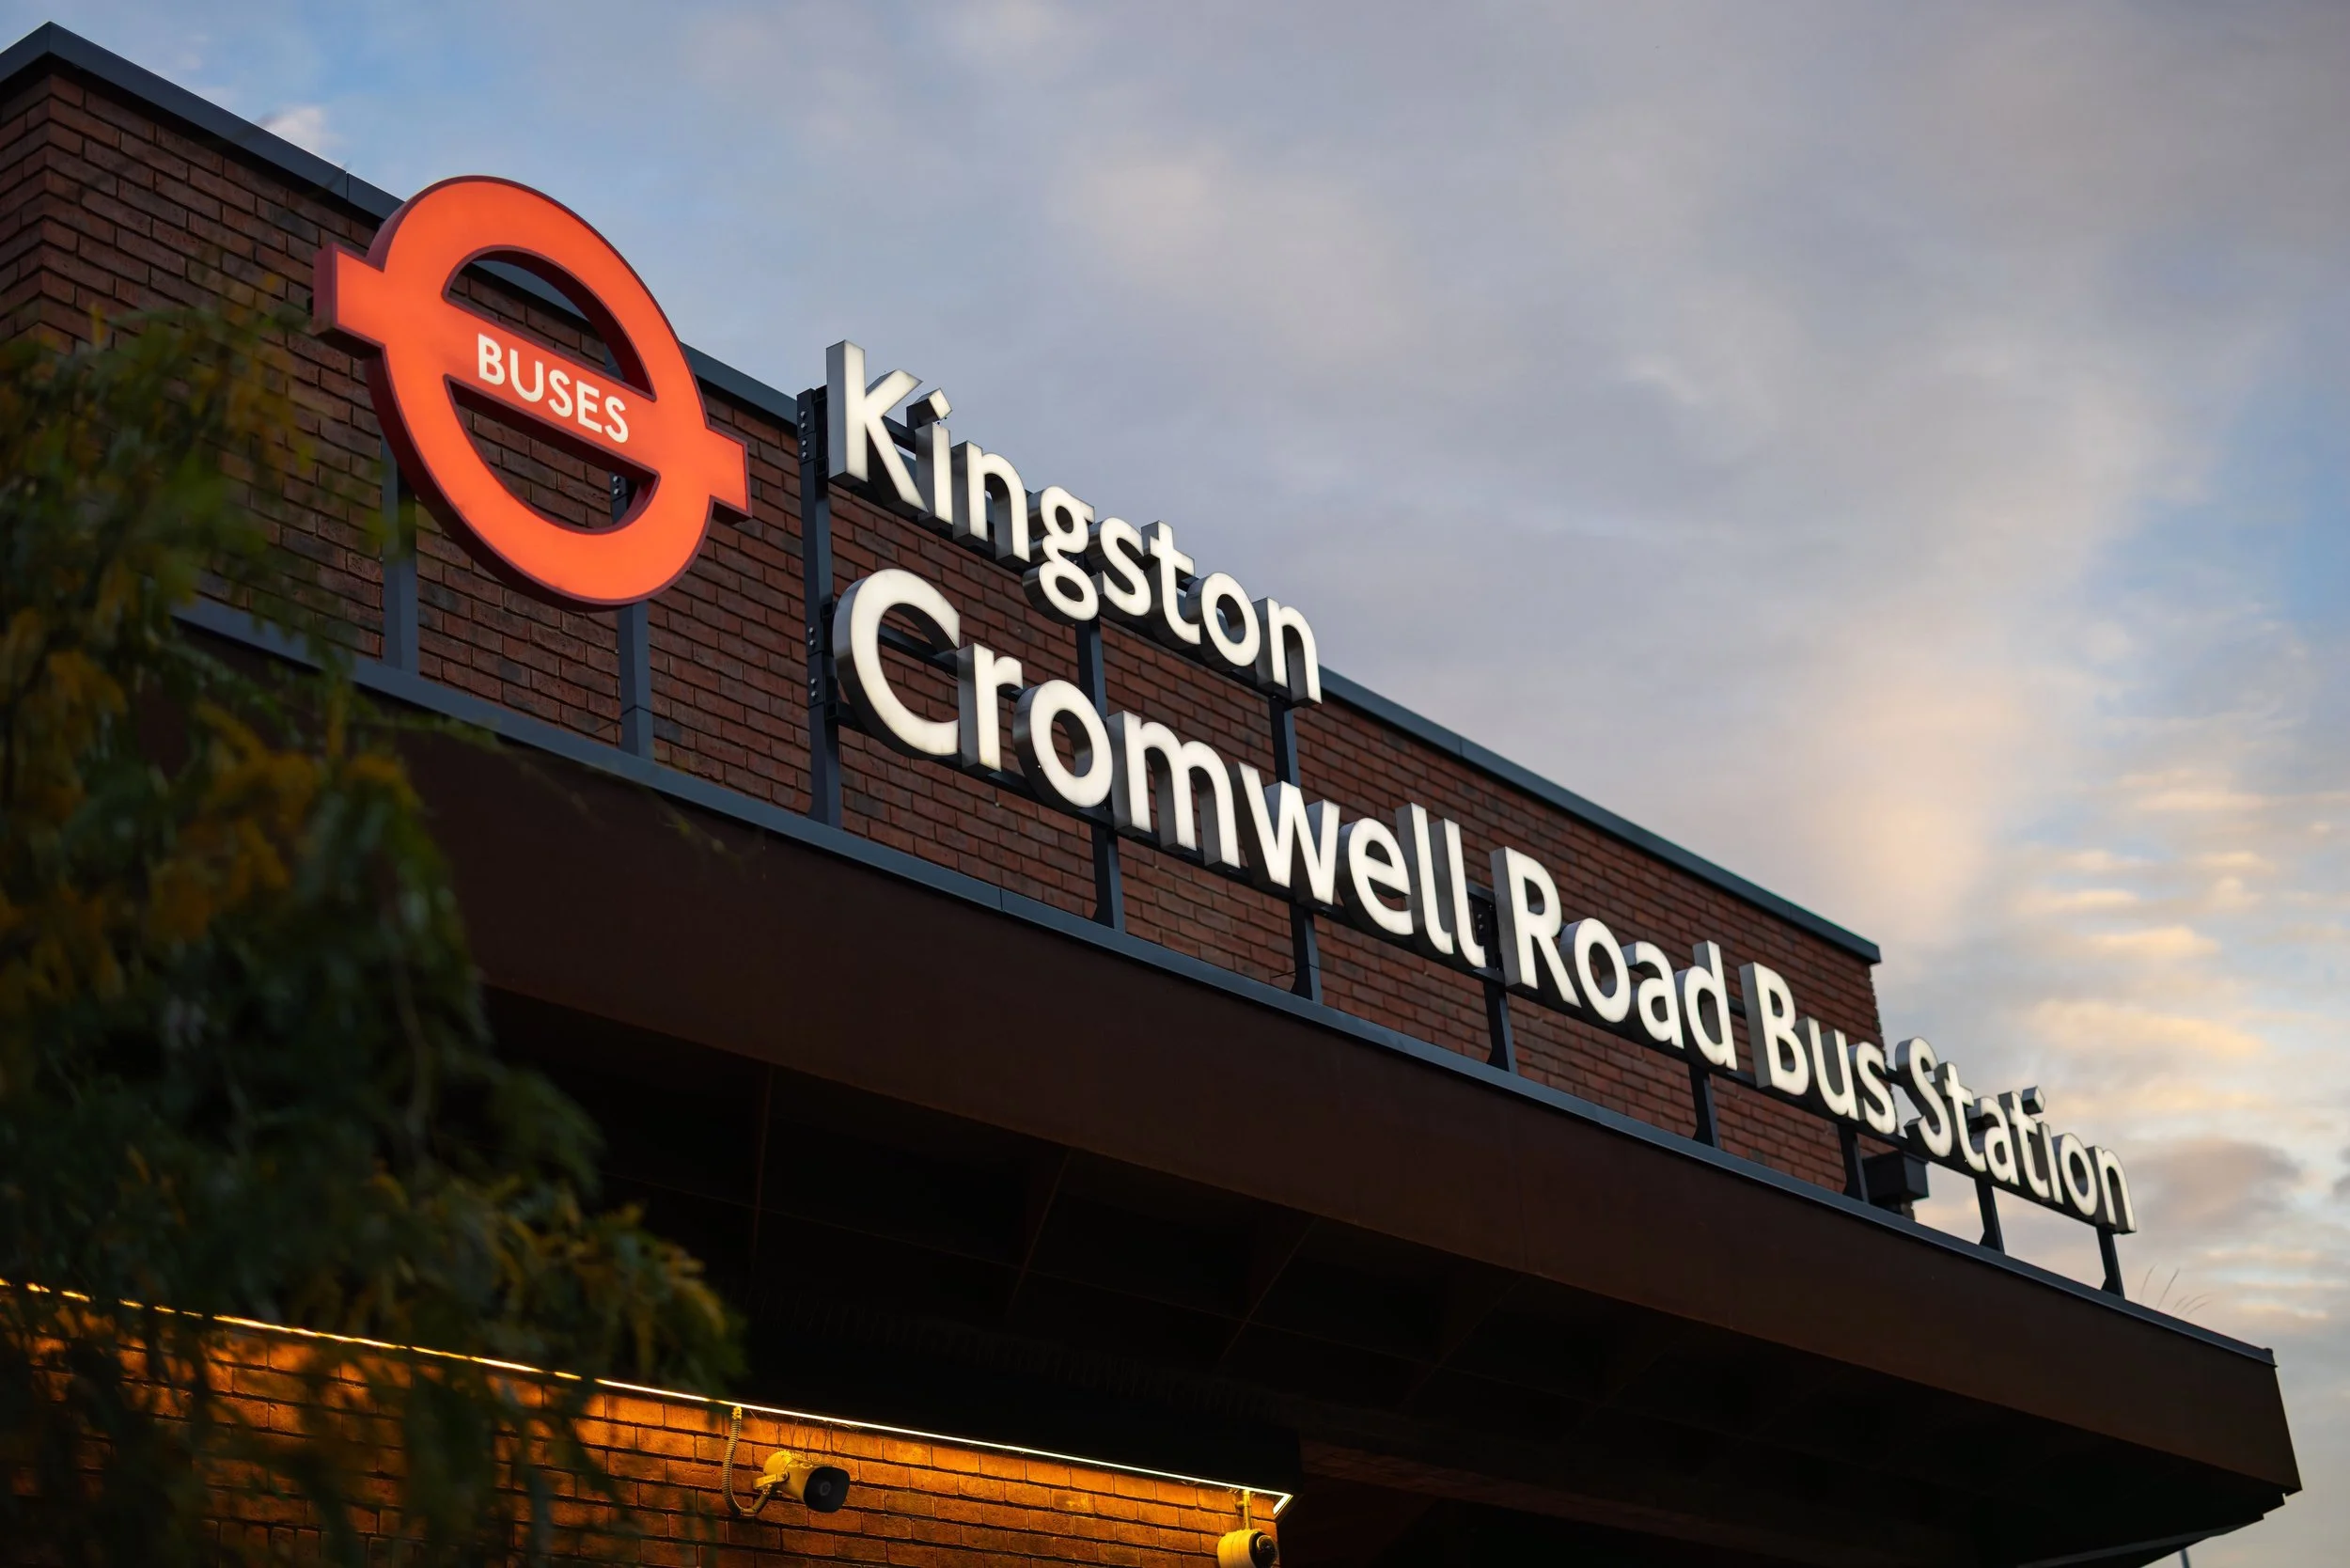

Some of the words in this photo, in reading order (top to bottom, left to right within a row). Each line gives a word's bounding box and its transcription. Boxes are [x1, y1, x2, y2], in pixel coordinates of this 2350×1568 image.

[478, 333, 629, 444] BUSES
[842, 340, 1322, 704] Kingston
[850, 568, 1486, 968] Cromwell
[1504, 846, 1737, 1072] Road
[1752, 962, 1898, 1135] Bus
[1906, 1038, 2137, 1232] Station
